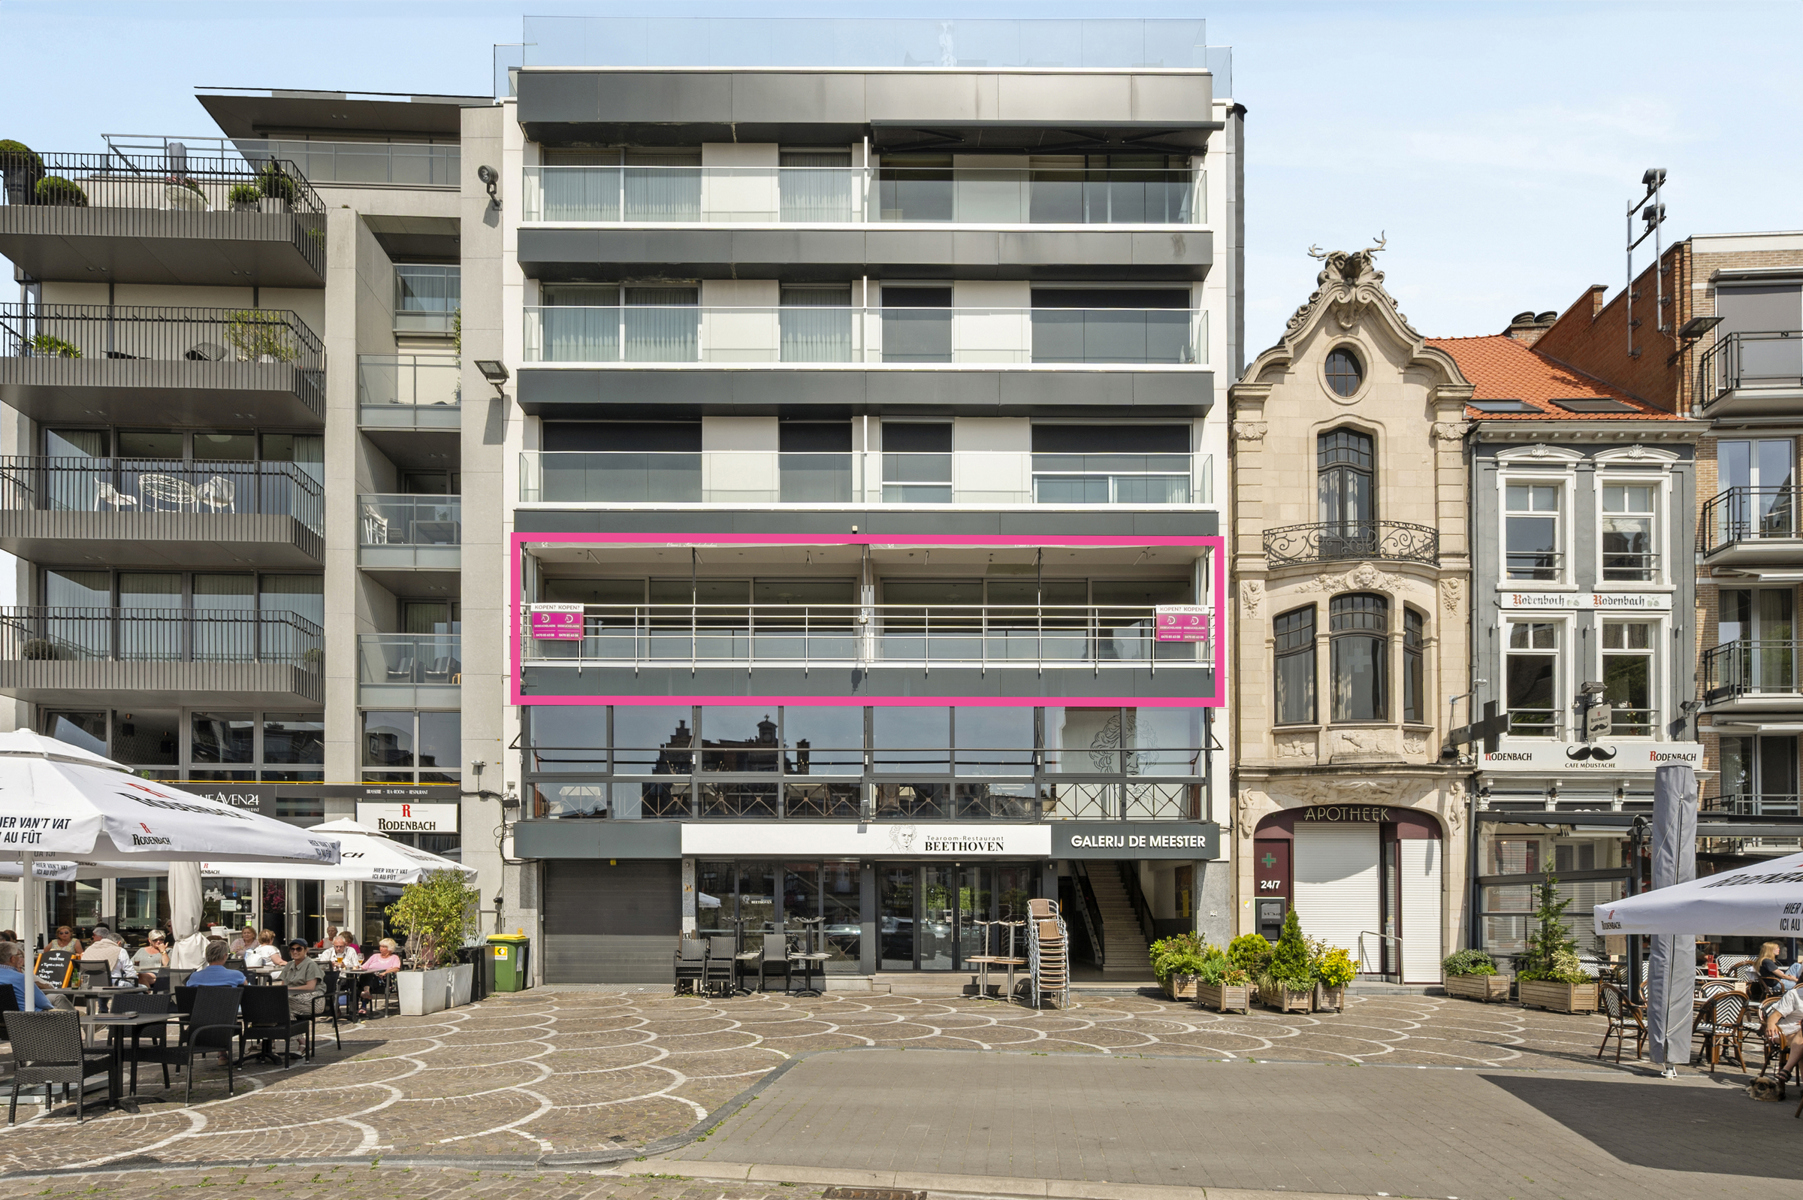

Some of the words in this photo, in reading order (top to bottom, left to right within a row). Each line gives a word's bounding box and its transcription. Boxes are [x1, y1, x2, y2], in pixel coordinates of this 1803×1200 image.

[1593, 594, 1645, 607] Rodenbach
[402, 804, 411, 818] R
[1304, 806, 1390, 822] APOTHEEK
[0, 816, 17, 829] IER
[20, 816, 50, 829] VAN'T
[52, 818, 71, 830] VAT
[378, 818, 436, 831] RODENBACH
[4, 831, 18, 844] AU
[21, 829, 42, 844] FÛT
[1070, 835, 1124, 849] GALERIJ
[1128, 835, 1146, 849] DE
[1149, 835, 1206, 849] MEESTER
[924, 841, 1004, 852] BEETHOVEN
[1260, 880, 1281, 890] 24/7
[1783, 902, 1802, 914] HIER
[1779, 918, 1790, 931] ICI
[1790, 918, 1801, 931] AU
